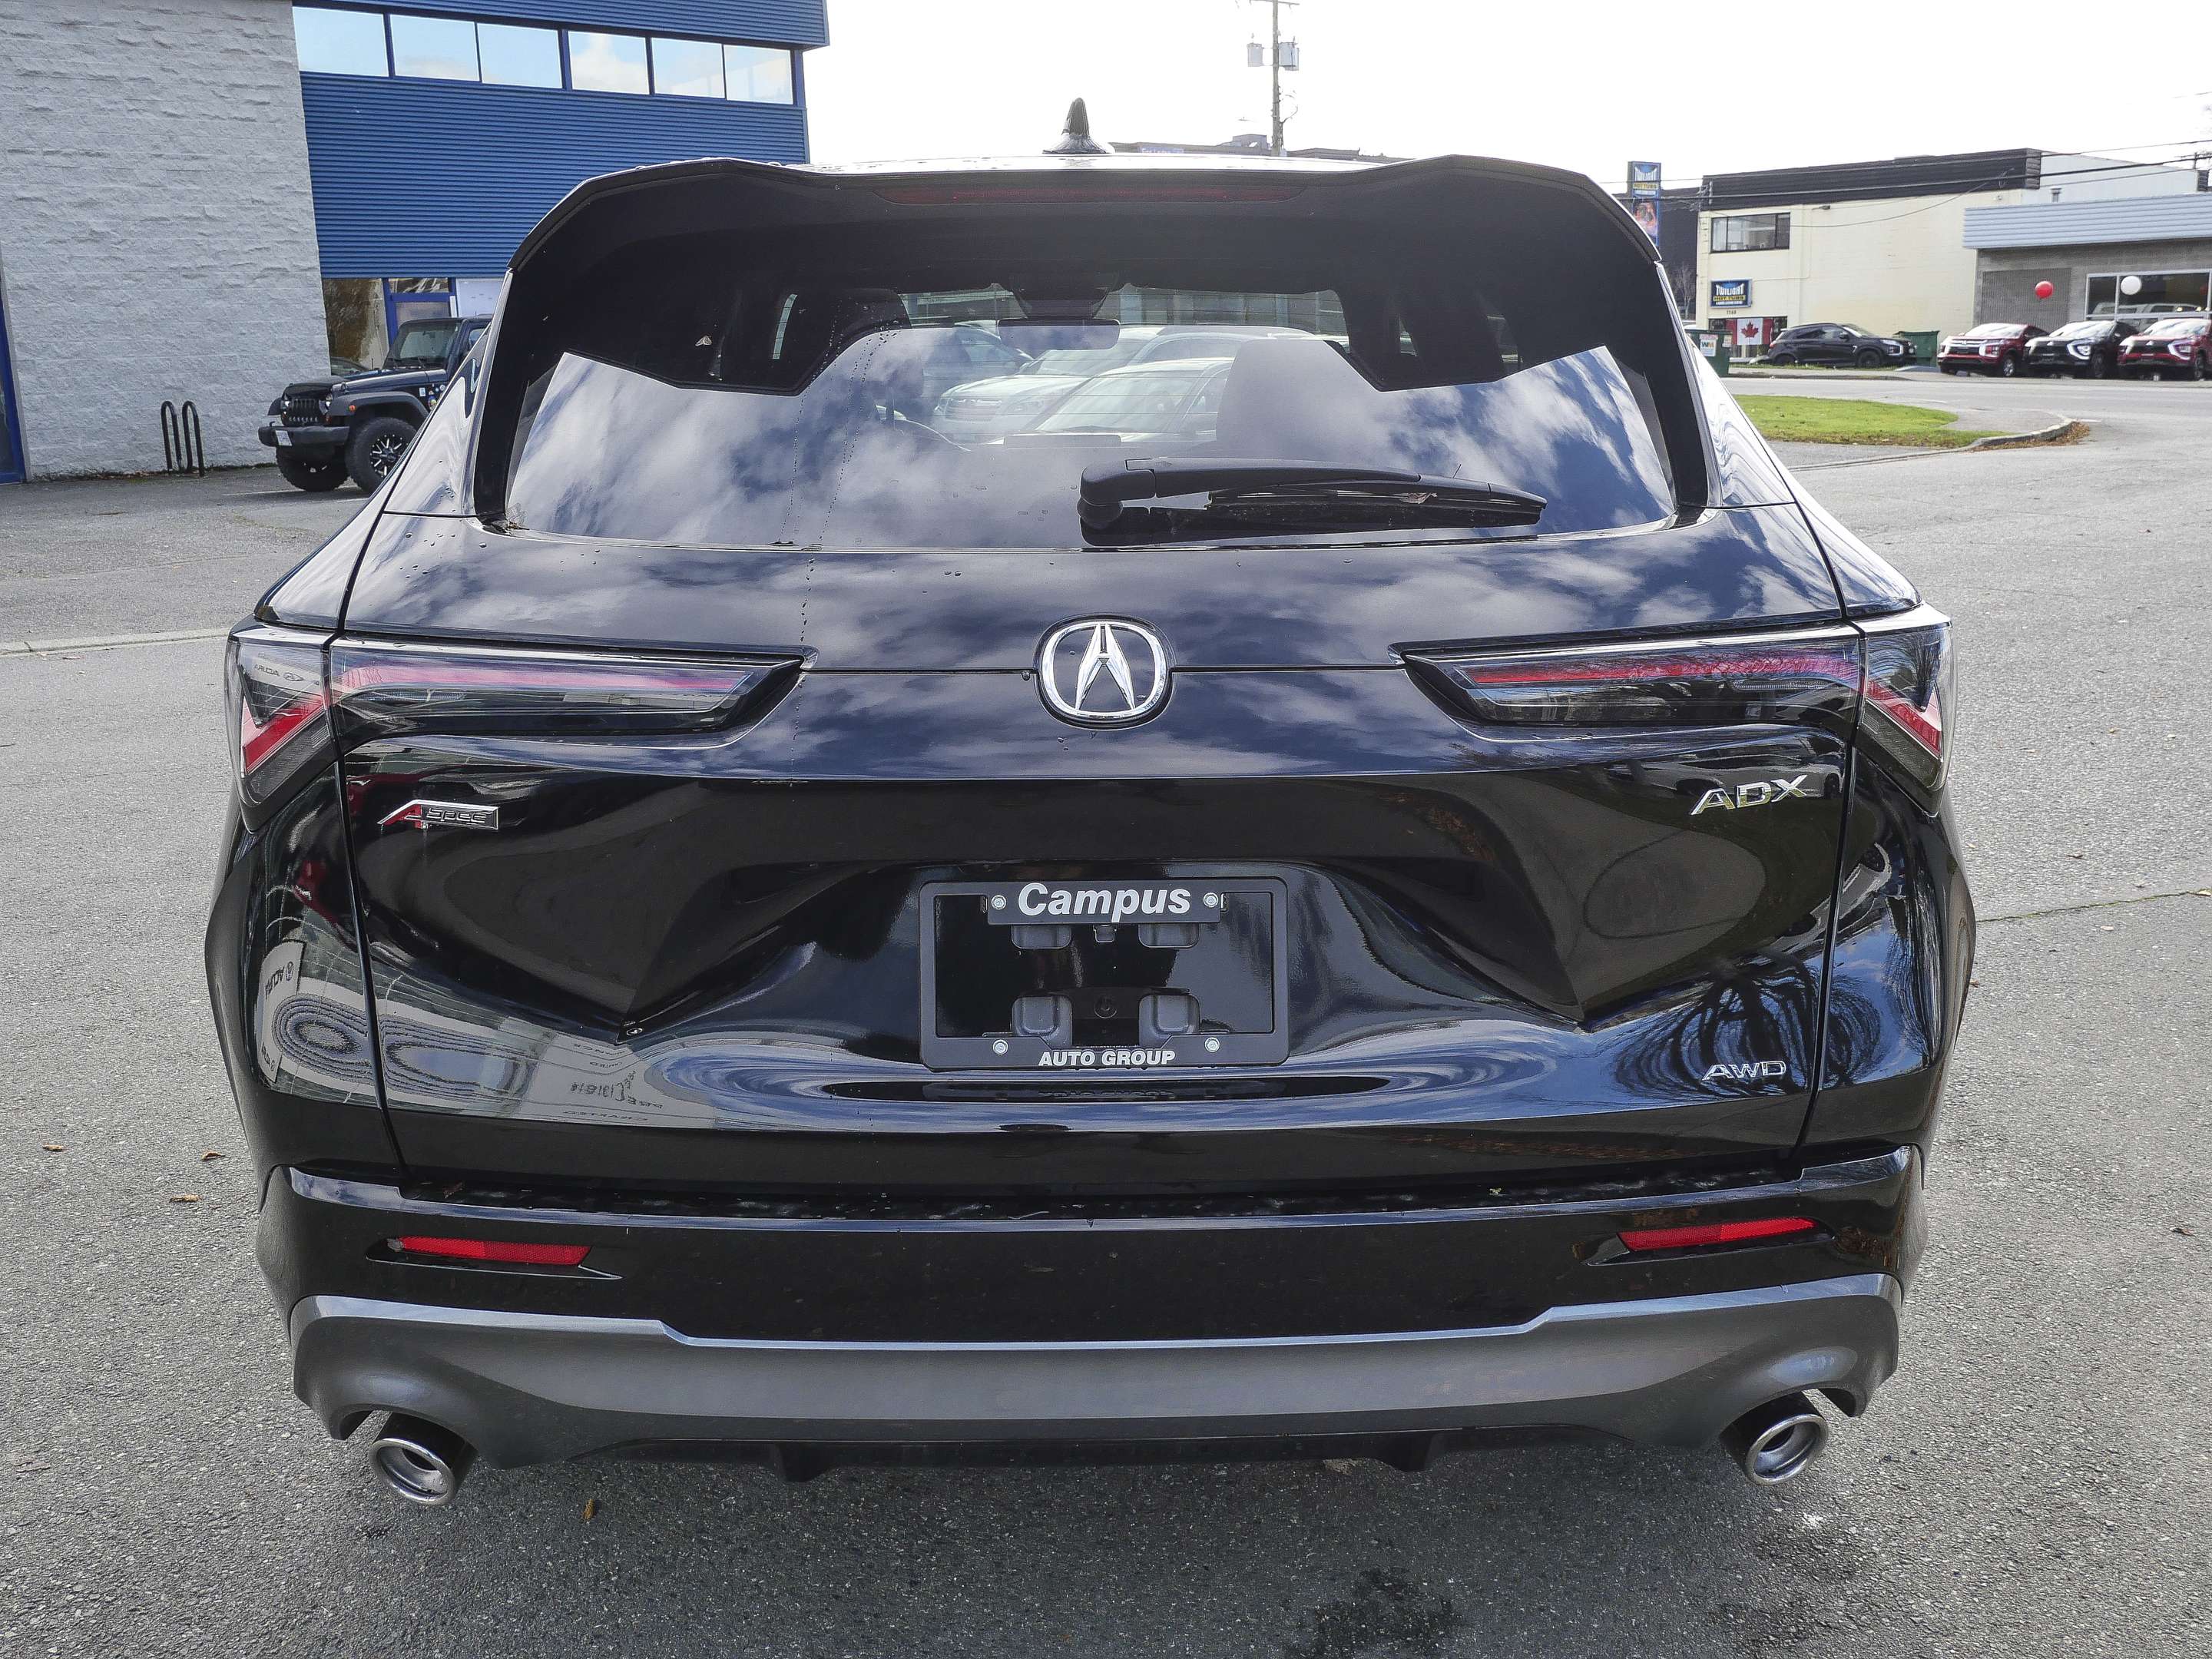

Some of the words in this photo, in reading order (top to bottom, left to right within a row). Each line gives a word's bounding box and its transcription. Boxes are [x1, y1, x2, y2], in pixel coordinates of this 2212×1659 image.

[1715, 283, 1744, 296] TWILIGHT
[1690, 774, 1807, 816] ADX
[1018, 882, 1192, 923] Campus
[1038, 1051, 1096, 1067] AUTO
[1101, 1050, 1177, 1066] GROUP
[1702, 1060, 1786, 1081] AWD
